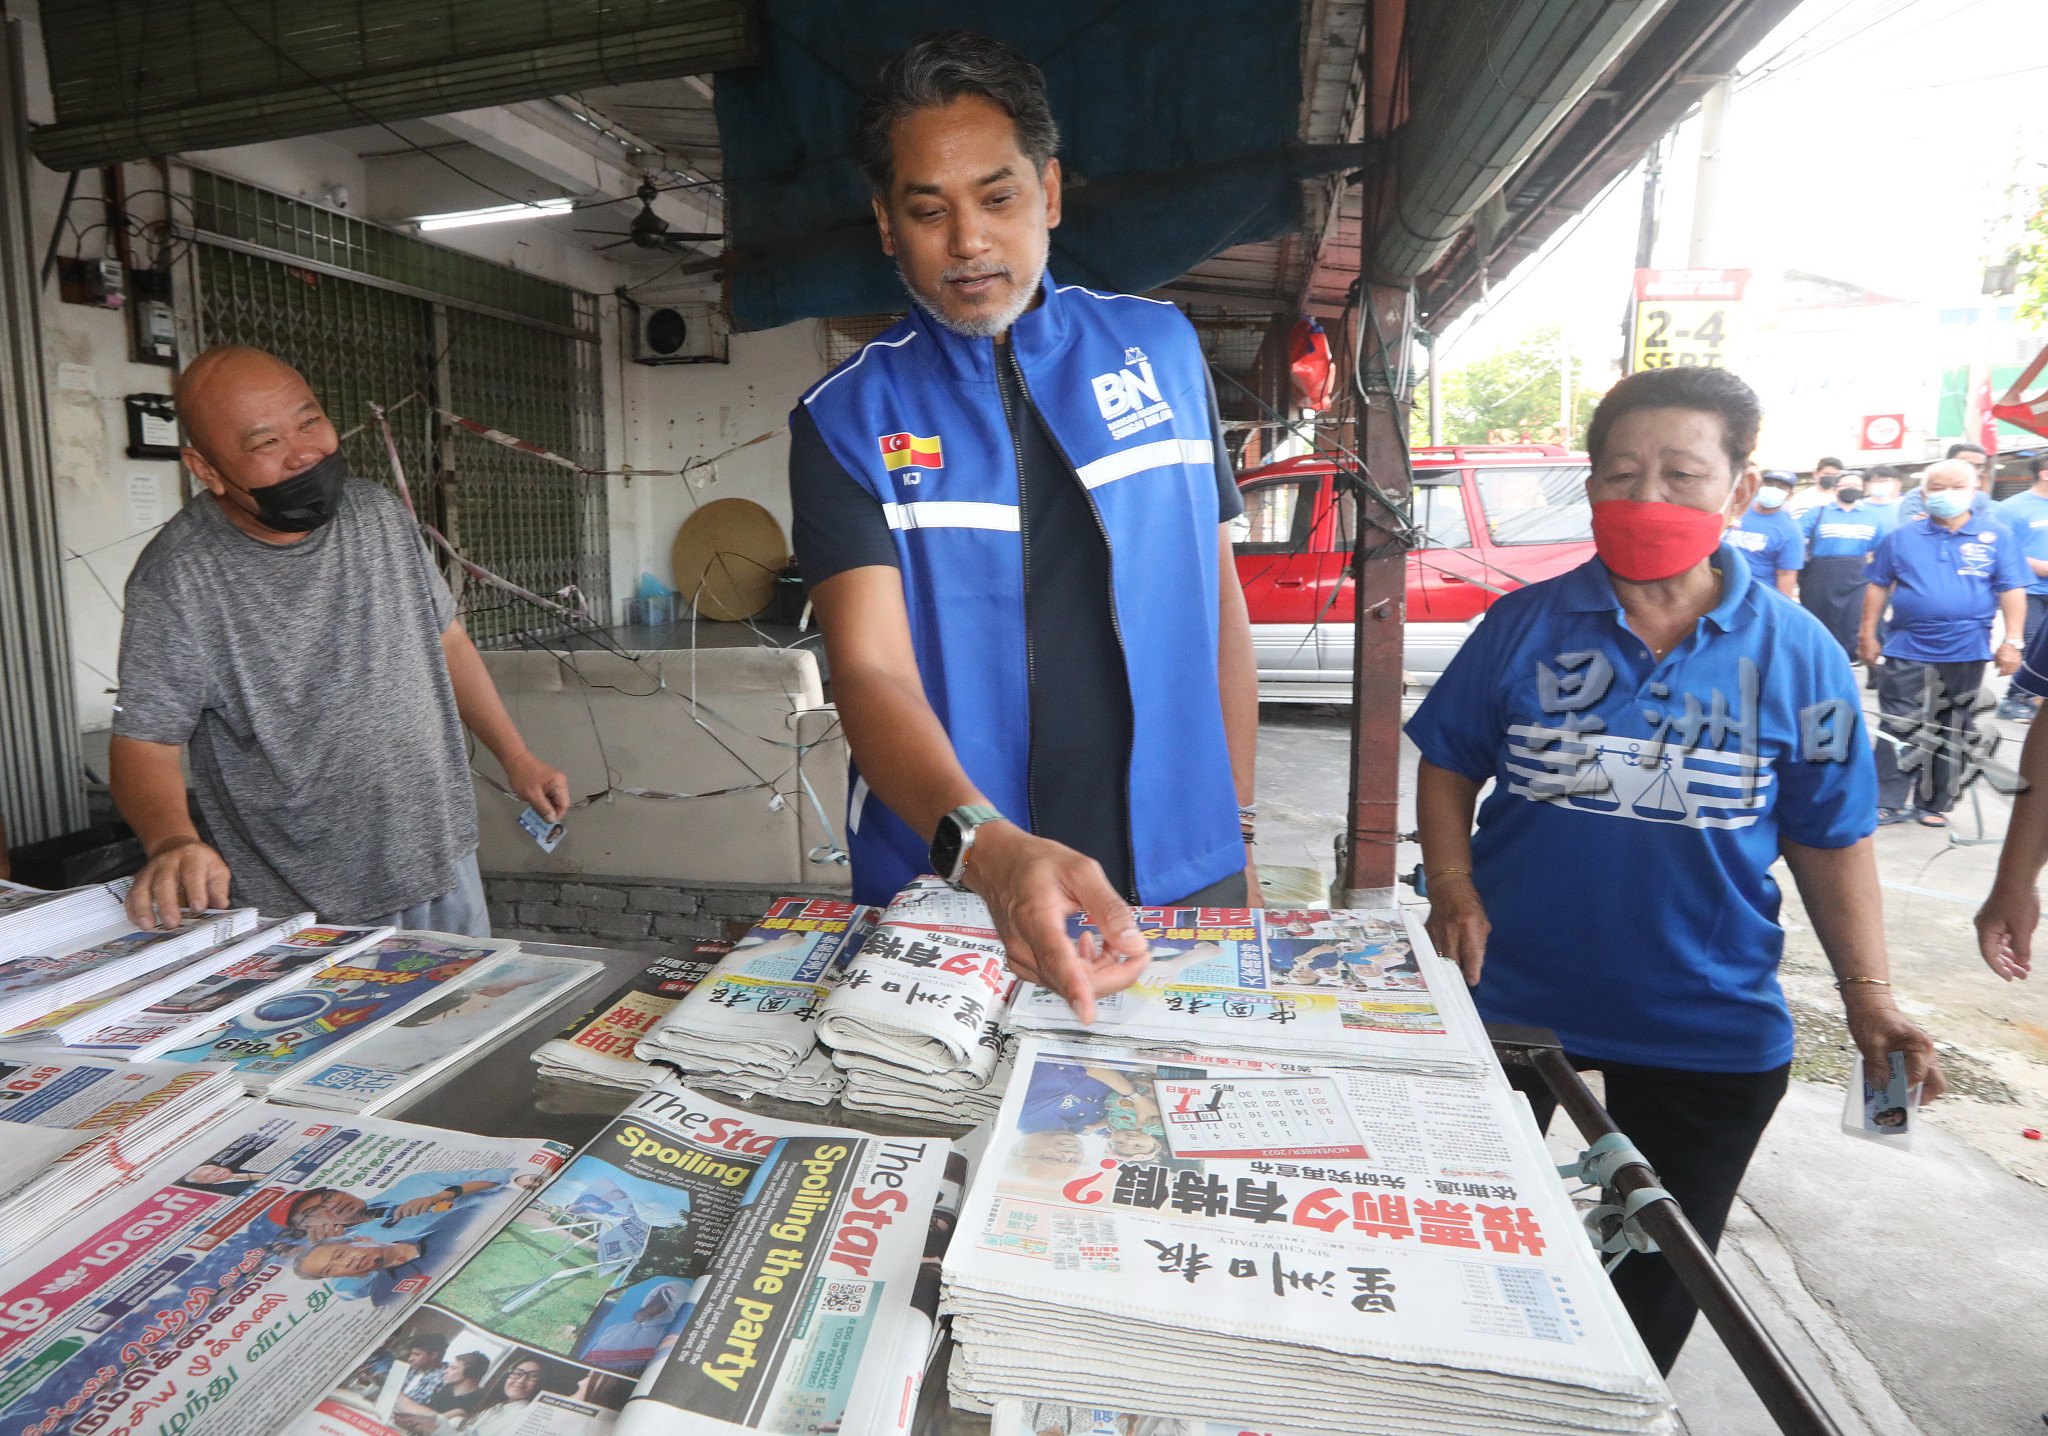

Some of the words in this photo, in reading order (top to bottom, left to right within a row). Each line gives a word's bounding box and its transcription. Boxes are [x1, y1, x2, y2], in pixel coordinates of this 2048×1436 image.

[1644, 309, 1726, 348] 2-4
[1091, 360, 1164, 421] BN
[902, 472, 922, 486] KJ
[1152, 927, 1257, 942] 投票前夕
[716, 981, 770, 994] PRESS
[1163, 990, 1225, 1000] PRESS
[1223, 993, 1296, 1006] CHINA
[1165, 996, 1297, 1025] 中國報
[213, 1036, 272, 1055] 849
[616, 1125, 750, 1187] Spoiling
[1260, 1148, 1285, 1156] 2022
[1250, 1160, 1406, 1190] 先研究再宣布
[769, 1143, 848, 1245] Spoiling
[80, 1193, 198, 1267] மலர்
[696, 1229, 718, 1243] ahead
[1217, 1237, 1259, 1249] DAILY
[1262, 1241, 1306, 1253] CHEW
[1308, 1248, 1331, 1258] SIN
[752, 1248, 804, 1296] the
[847, 1317, 856, 1326] IS
[830, 1325, 844, 1348] YOUR
[843, 1325, 854, 1341] ESG
[700, 1296, 776, 1393] party
[816, 1347, 836, 1390] FEEDBACK
[826, 1340, 848, 1390] IMPORTANT?
